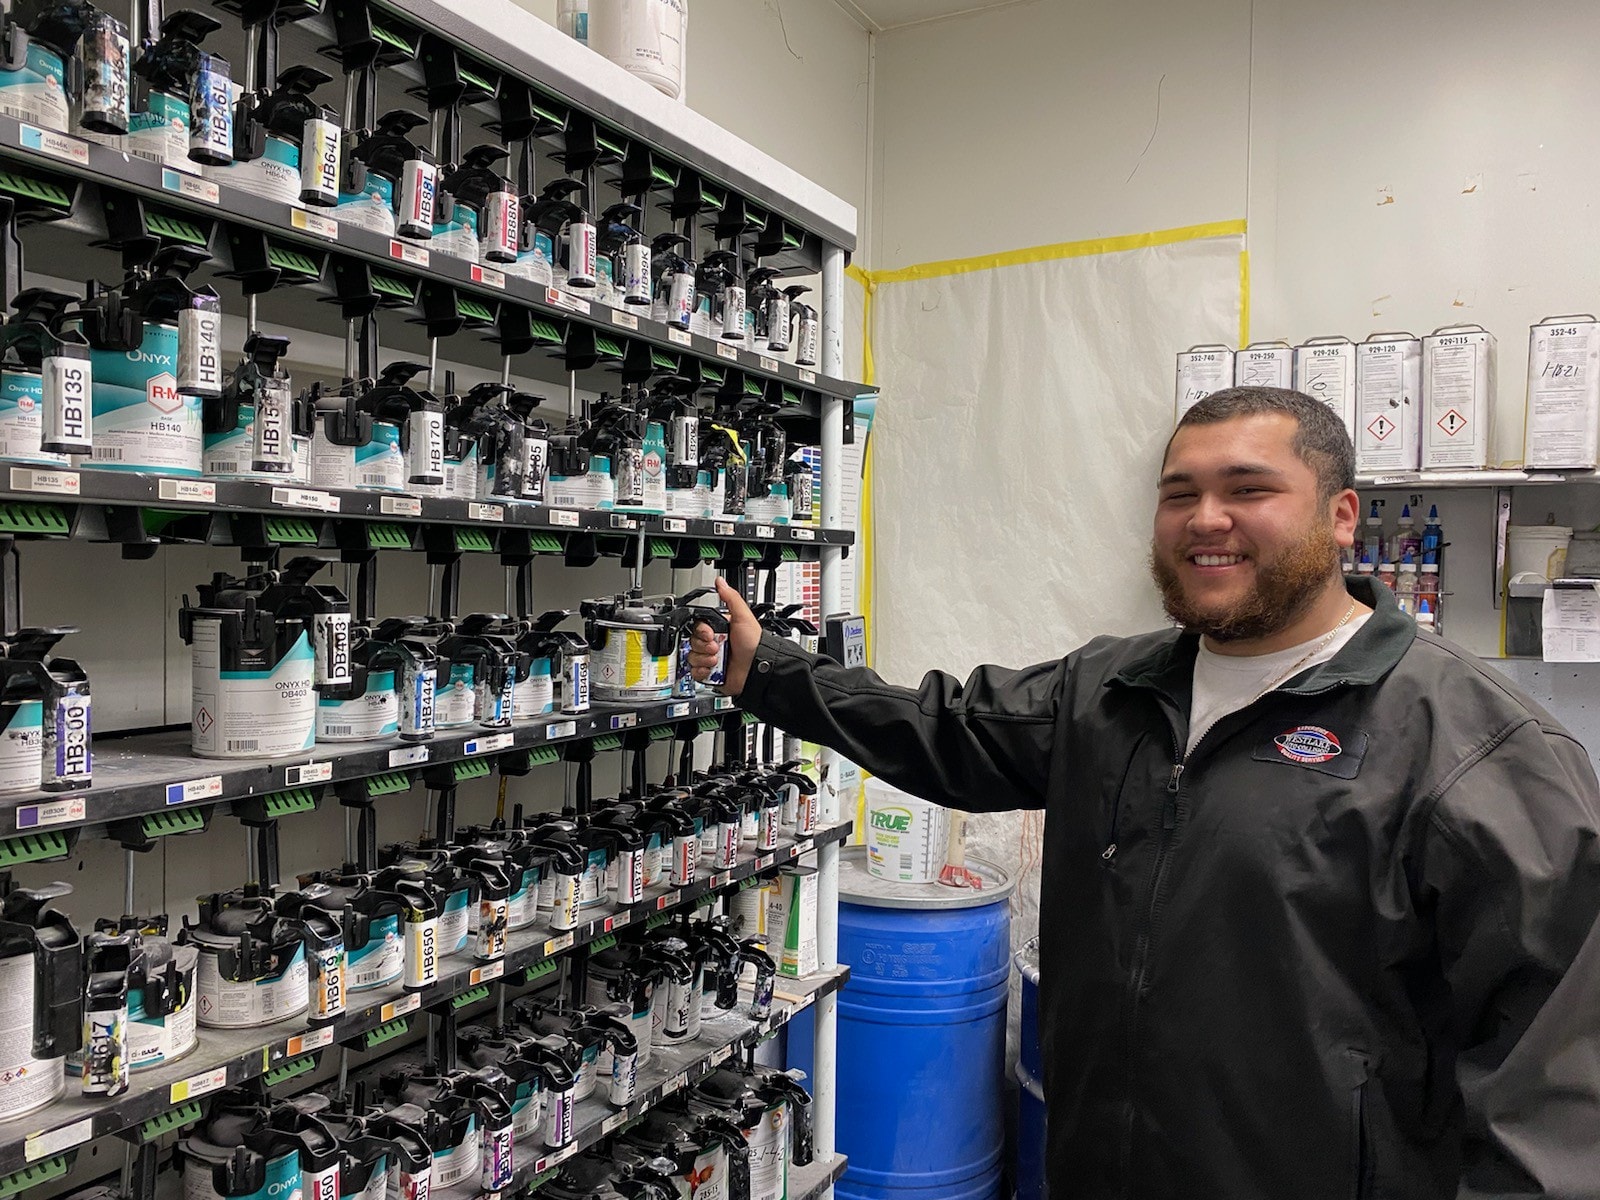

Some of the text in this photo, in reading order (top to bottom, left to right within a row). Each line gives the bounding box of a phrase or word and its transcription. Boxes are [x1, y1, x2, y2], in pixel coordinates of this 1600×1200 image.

[212, 83, 228, 147] HB46L
[322, 132, 339, 190] HB64L
[420, 172, 434, 225] HB88L
[507, 198, 519, 251] HB88N
[588, 231, 596, 277] HB88M
[641, 250, 652, 295] HB99K
[200, 319, 215, 384] HB140
[1439, 337, 1468, 345] 929-115
[1550, 328, 1577, 336] 352-45
[126, 348, 172, 366] ONYX
[64, 368, 83, 438] HB135
[153, 385, 180, 401] R-M
[150, 421, 182, 433] HB140
[263, 392, 280, 455] HB15
[430, 420, 441, 472] HB170
[37, 475, 59, 484] HB135
[180, 485, 199, 493] HB140
[301, 494, 318, 502] HB150
[335, 621, 347, 678] DB403
[275, 681, 300, 690] ONYX
[281, 689, 307, 699] DB403
[421, 677, 434, 729] HB444
[579, 662, 588, 705] HB469
[66, 706, 84, 776] HB300
[870, 810, 910, 831] TRUE
[633, 854, 643, 896] HB730
[494, 906, 505, 953] HB0
[423, 927, 434, 980] HB650
[327, 955, 340, 1012] HB619
[268, 1174, 298, 1196] ONYX
